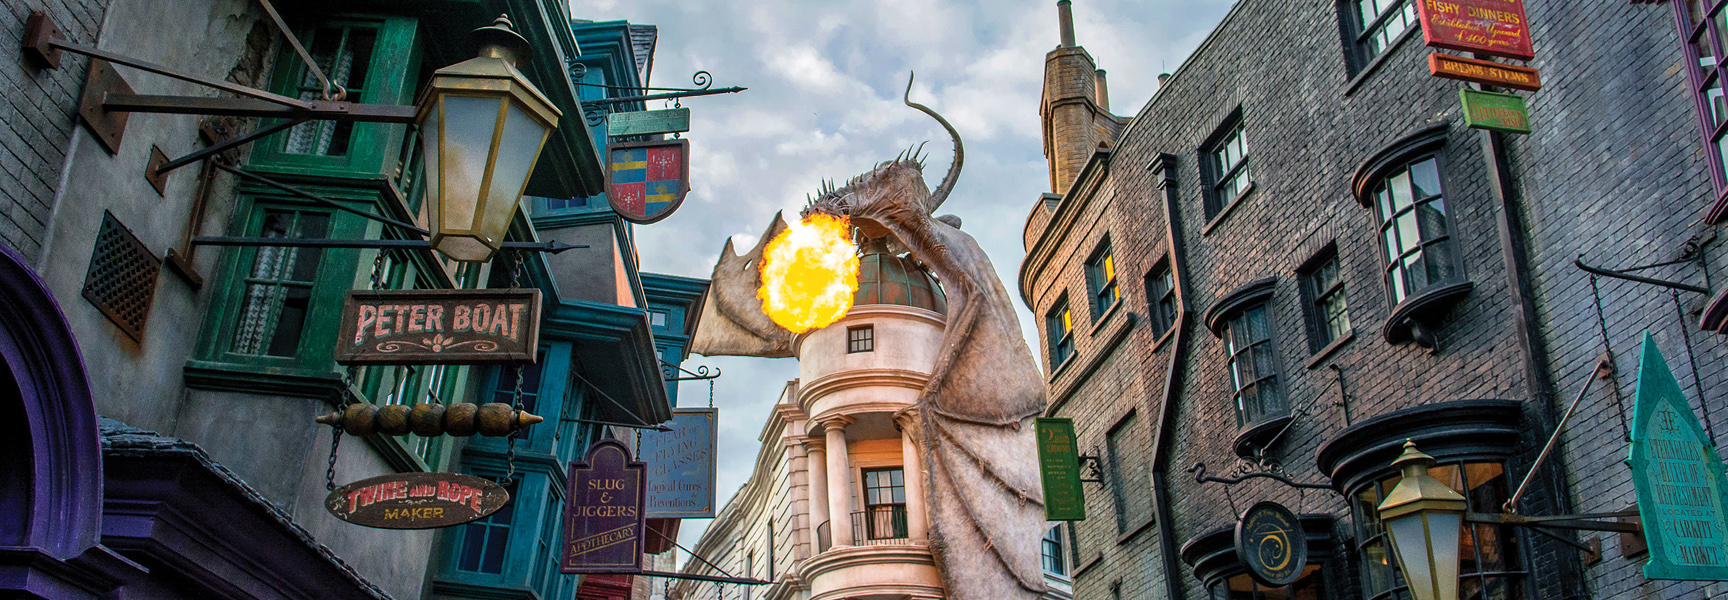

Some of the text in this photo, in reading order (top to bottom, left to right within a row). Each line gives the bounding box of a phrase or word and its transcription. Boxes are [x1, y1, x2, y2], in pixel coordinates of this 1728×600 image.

[1426, 0, 1520, 24] FISHY DINNERS
[1430, 13, 1521, 38] Established Upward
[1454, 30, 1510, 47] of 400 years
[1443, 60, 1485, 76] BREWS
[1489, 67, 1529, 83] STEWS
[355, 303, 526, 345] PETER BOAT
[655, 427, 686, 447] FEAR
[655, 437, 698, 462] FLYING
[1658, 461, 1700, 484] ELIXIR OF
[588, 479, 625, 491] SLUG
[678, 480, 702, 492] Cures
[1655, 484, 1714, 507] REFRESHMENT
[347, 480, 483, 514] TWINE AND ROPE
[600, 491, 614, 504] &
[650, 495, 697, 508] Preventions
[384, 508, 443, 519] MAKER
[573, 506, 635, 516] JIGGERS
[1673, 518, 1713, 539] CARKITT
[570, 527, 635, 554] APOTHECARY
[1679, 545, 1719, 565] MARKET
